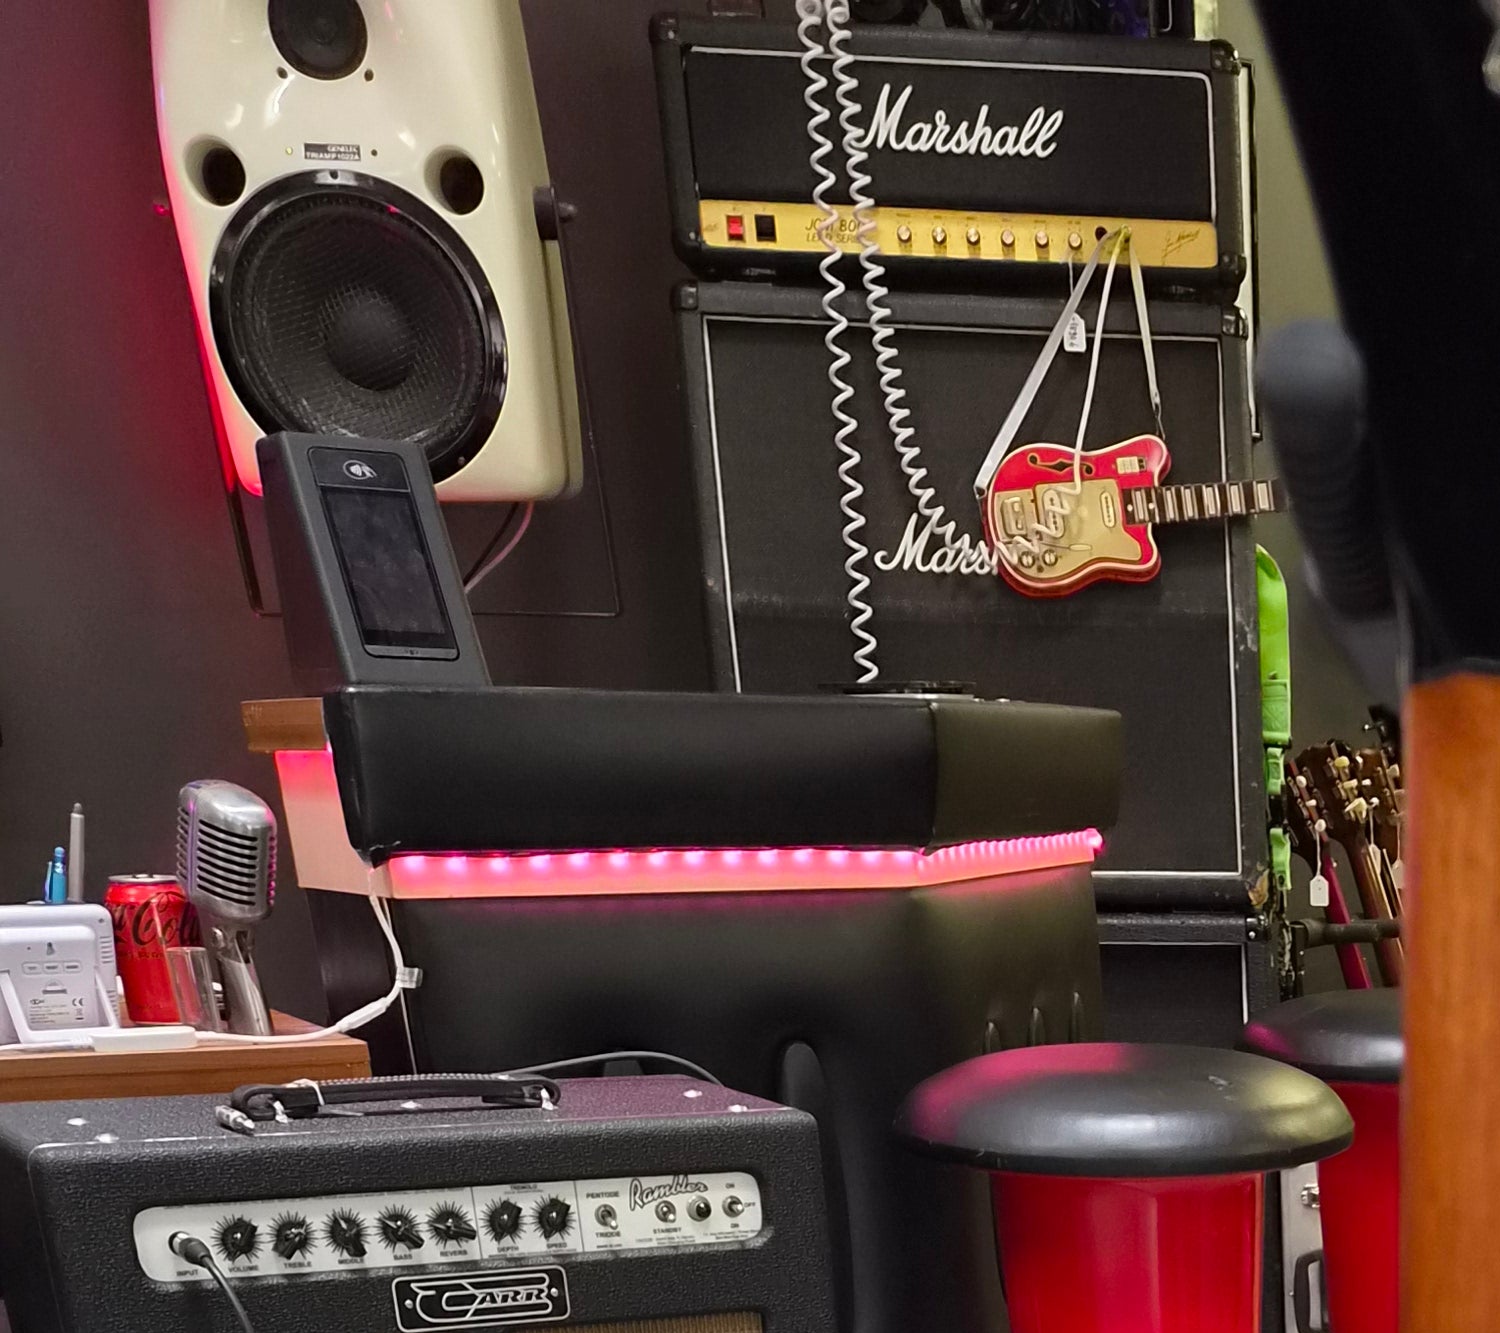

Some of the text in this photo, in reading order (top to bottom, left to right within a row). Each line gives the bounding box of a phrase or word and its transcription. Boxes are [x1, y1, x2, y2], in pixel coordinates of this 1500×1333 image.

[850, 83, 1063, 158] Marshall
[874, 512, 998, 575] Mars
[586, 1190, 620, 1199] PENTODE
[629, 1174, 708, 1212] Rambler
[228, 1265, 259, 1273] VOLUME
[283, 1261, 312, 1269] TREBLE
[393, 1253, 413, 1261] BASS
[410, 1273, 552, 1324] CARR
